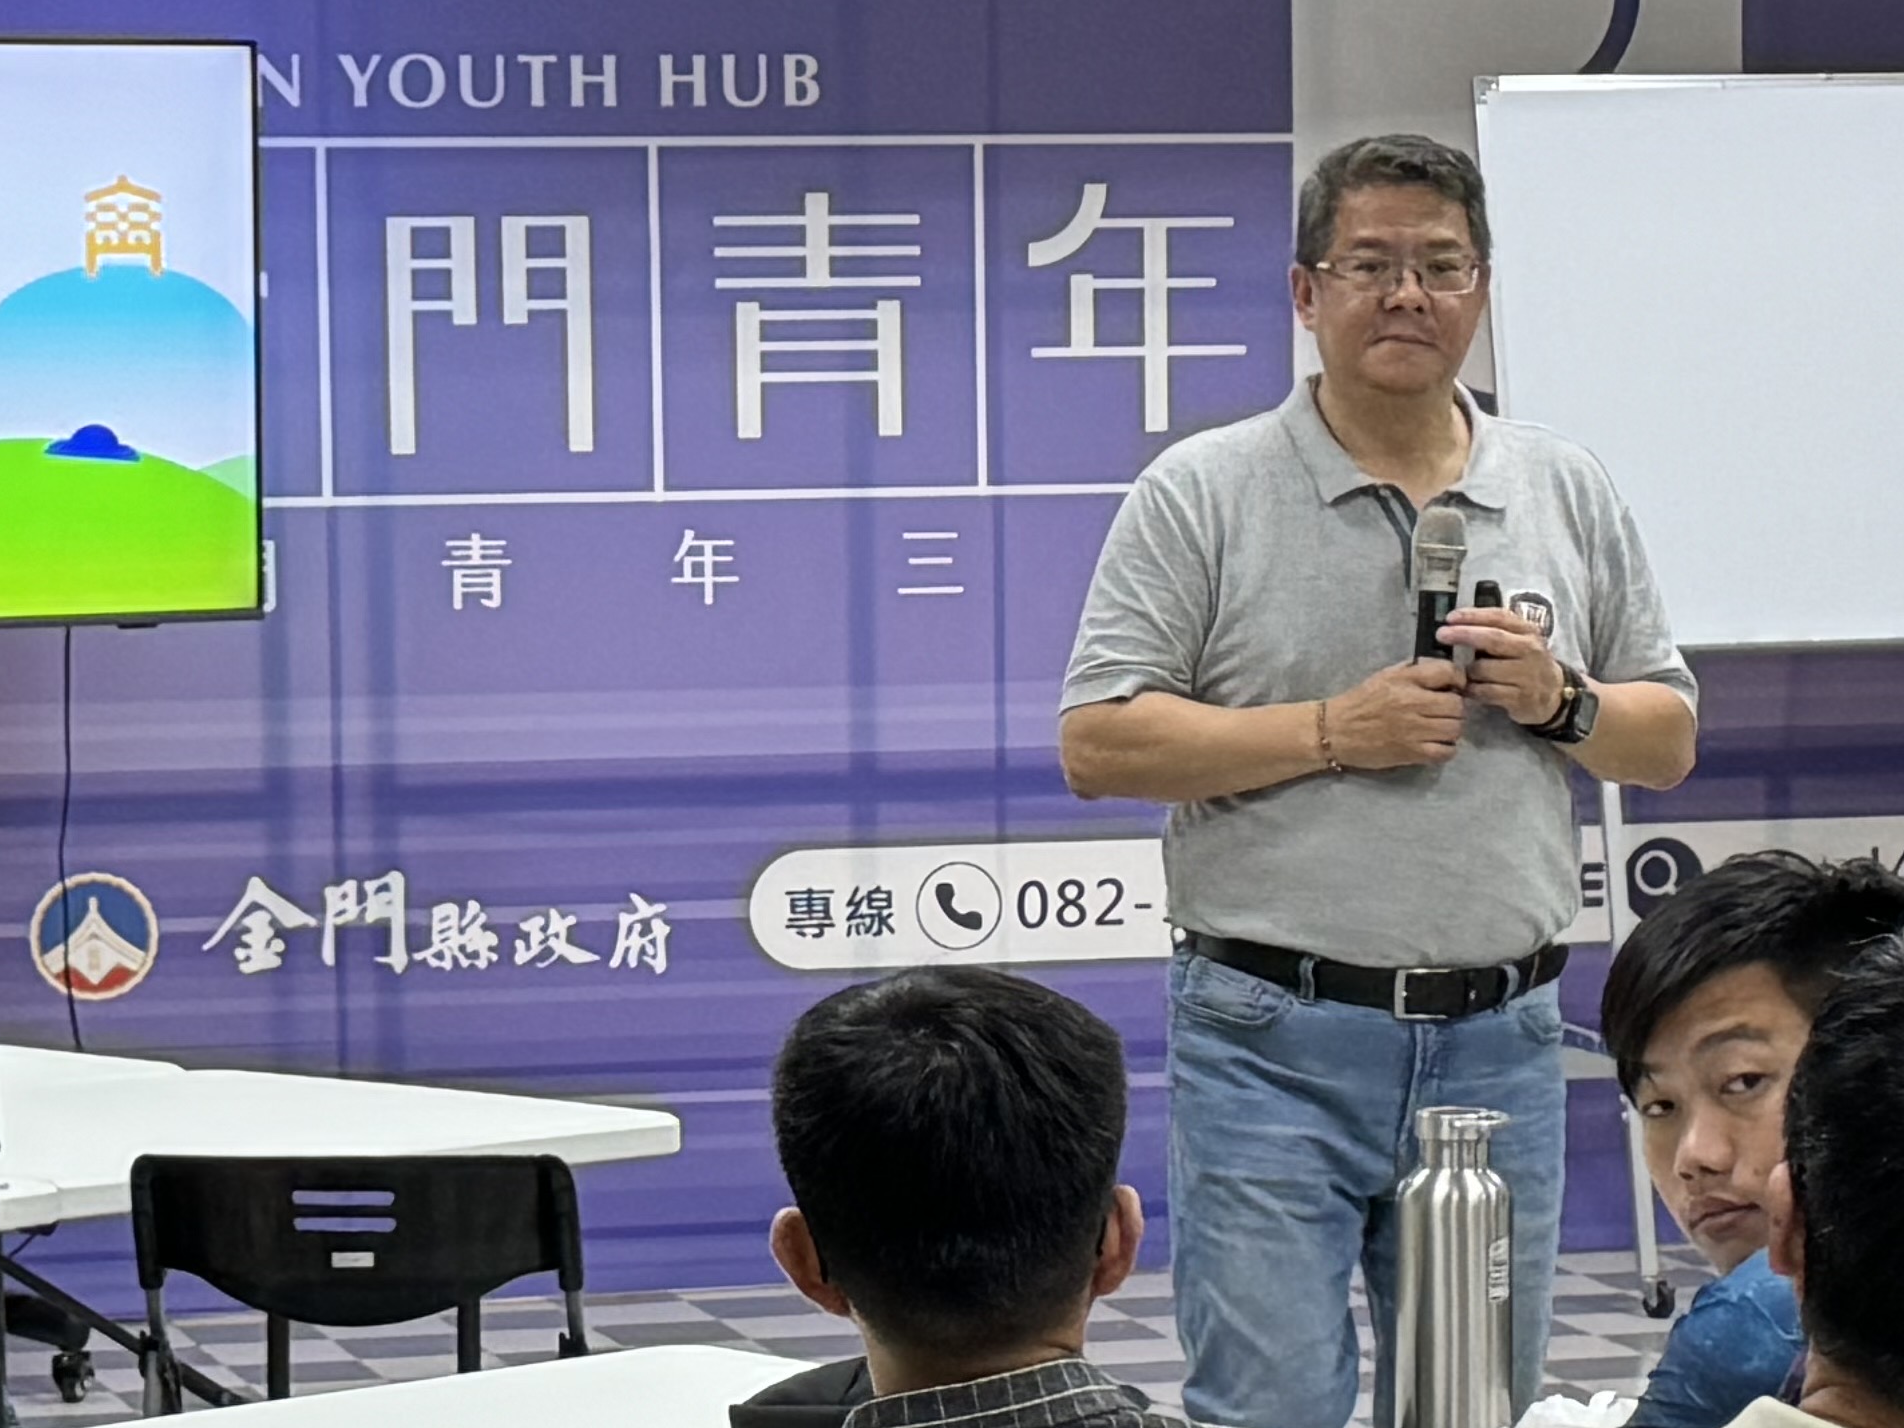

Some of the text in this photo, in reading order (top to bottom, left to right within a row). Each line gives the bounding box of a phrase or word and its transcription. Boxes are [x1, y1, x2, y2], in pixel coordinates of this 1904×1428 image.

[337, 52, 618, 109] YOUTH
[659, 53, 823, 108] HUB
[260, 182, 1247, 455] 門青年
[262, 528, 964, 611] 青年三
[202, 871, 673, 976] 金門縣政府
[783, 884, 897, 940] 專線
